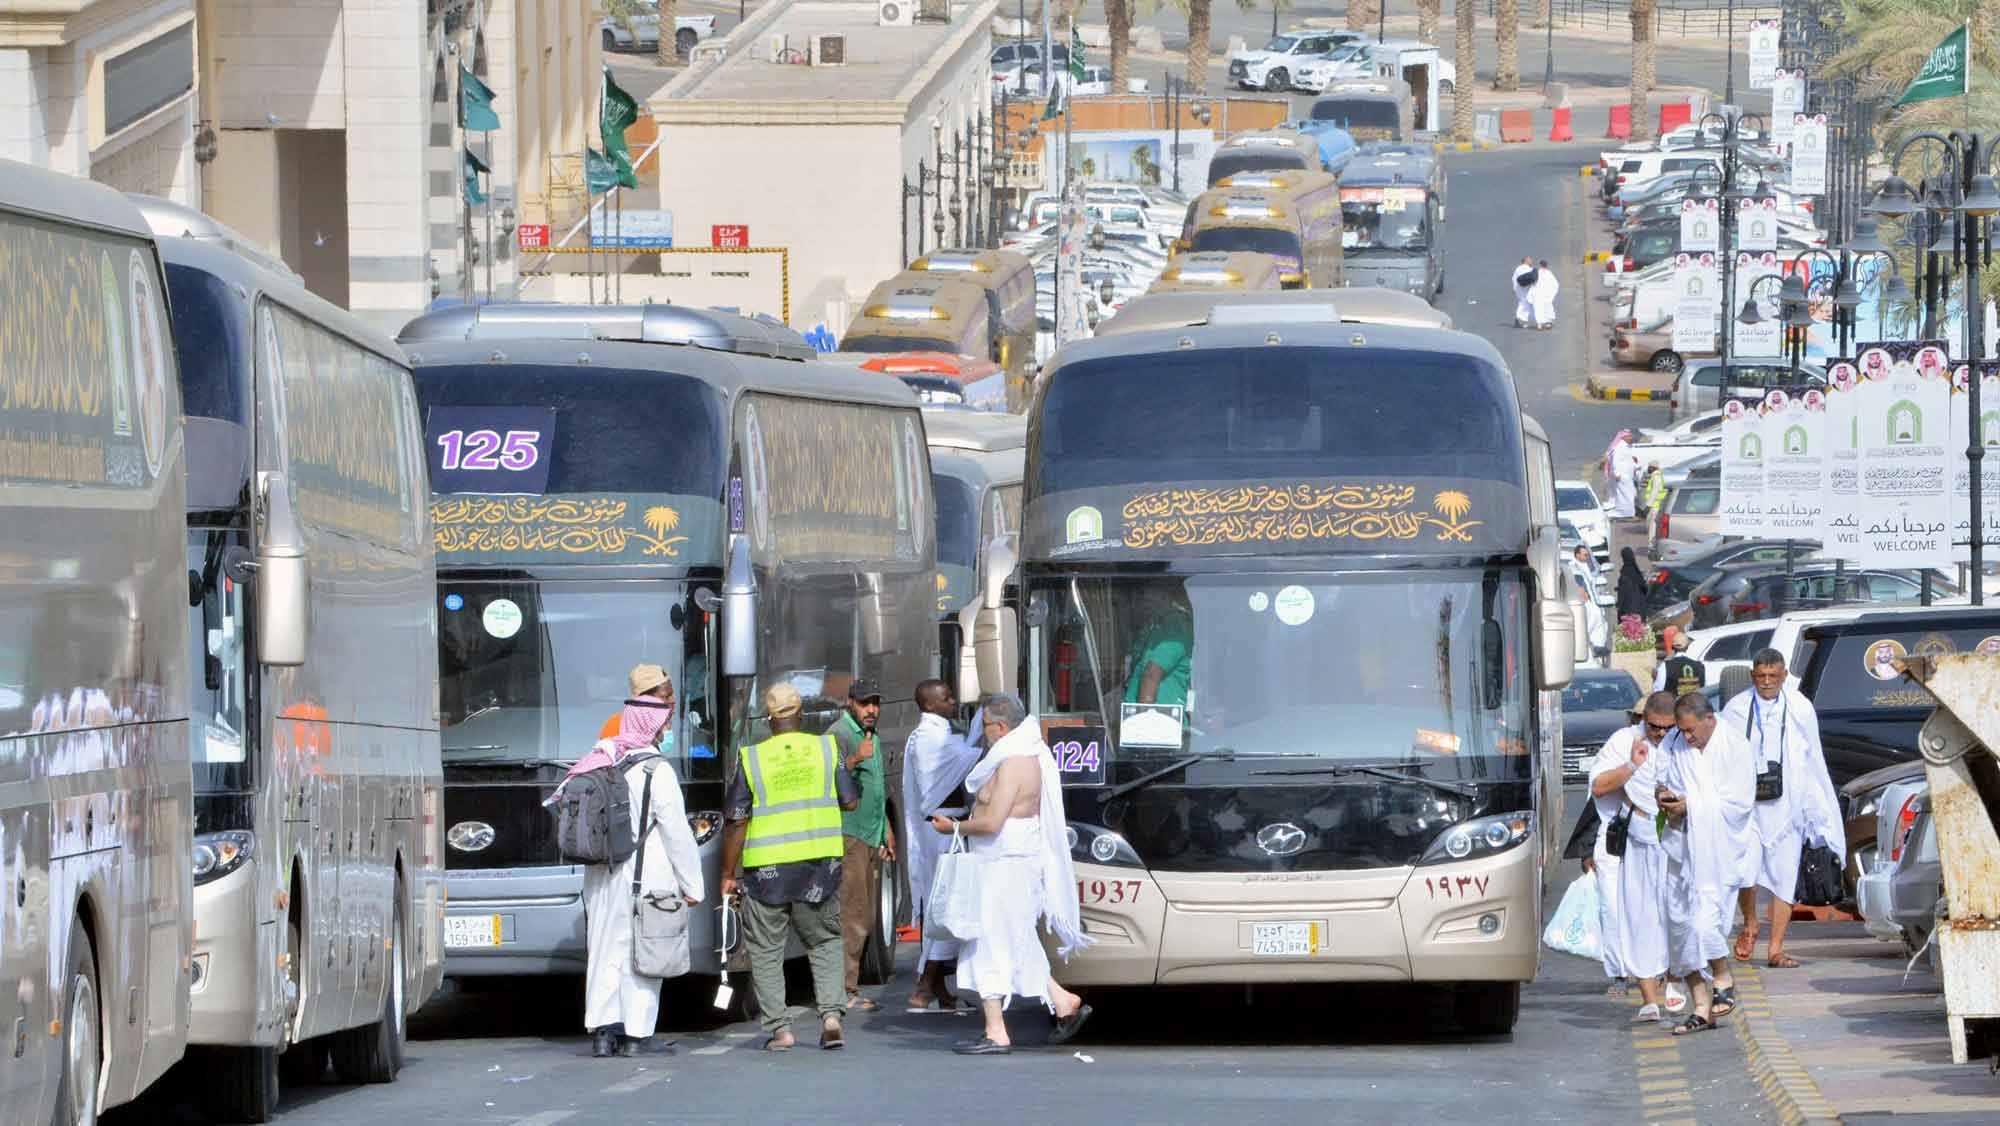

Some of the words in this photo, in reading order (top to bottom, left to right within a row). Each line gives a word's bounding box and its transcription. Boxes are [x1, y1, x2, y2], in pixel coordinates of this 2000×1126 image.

[521, 236, 541, 246] EXIT
[720, 237, 740, 247] EXIT
[437, 429, 540, 471] 125
[1332, 482, 1416, 510] ضيوف
[1864, 518, 1899, 537] بكم
[1874, 539, 1936, 551] WELCOME
[1053, 741, 1100, 772] 124
[1077, 880, 1142, 903] 1937
[1426, 875, 1489, 899] ١٩٣٧
[444, 934, 469, 946] 159
[1256, 940, 1285, 953] 7453
